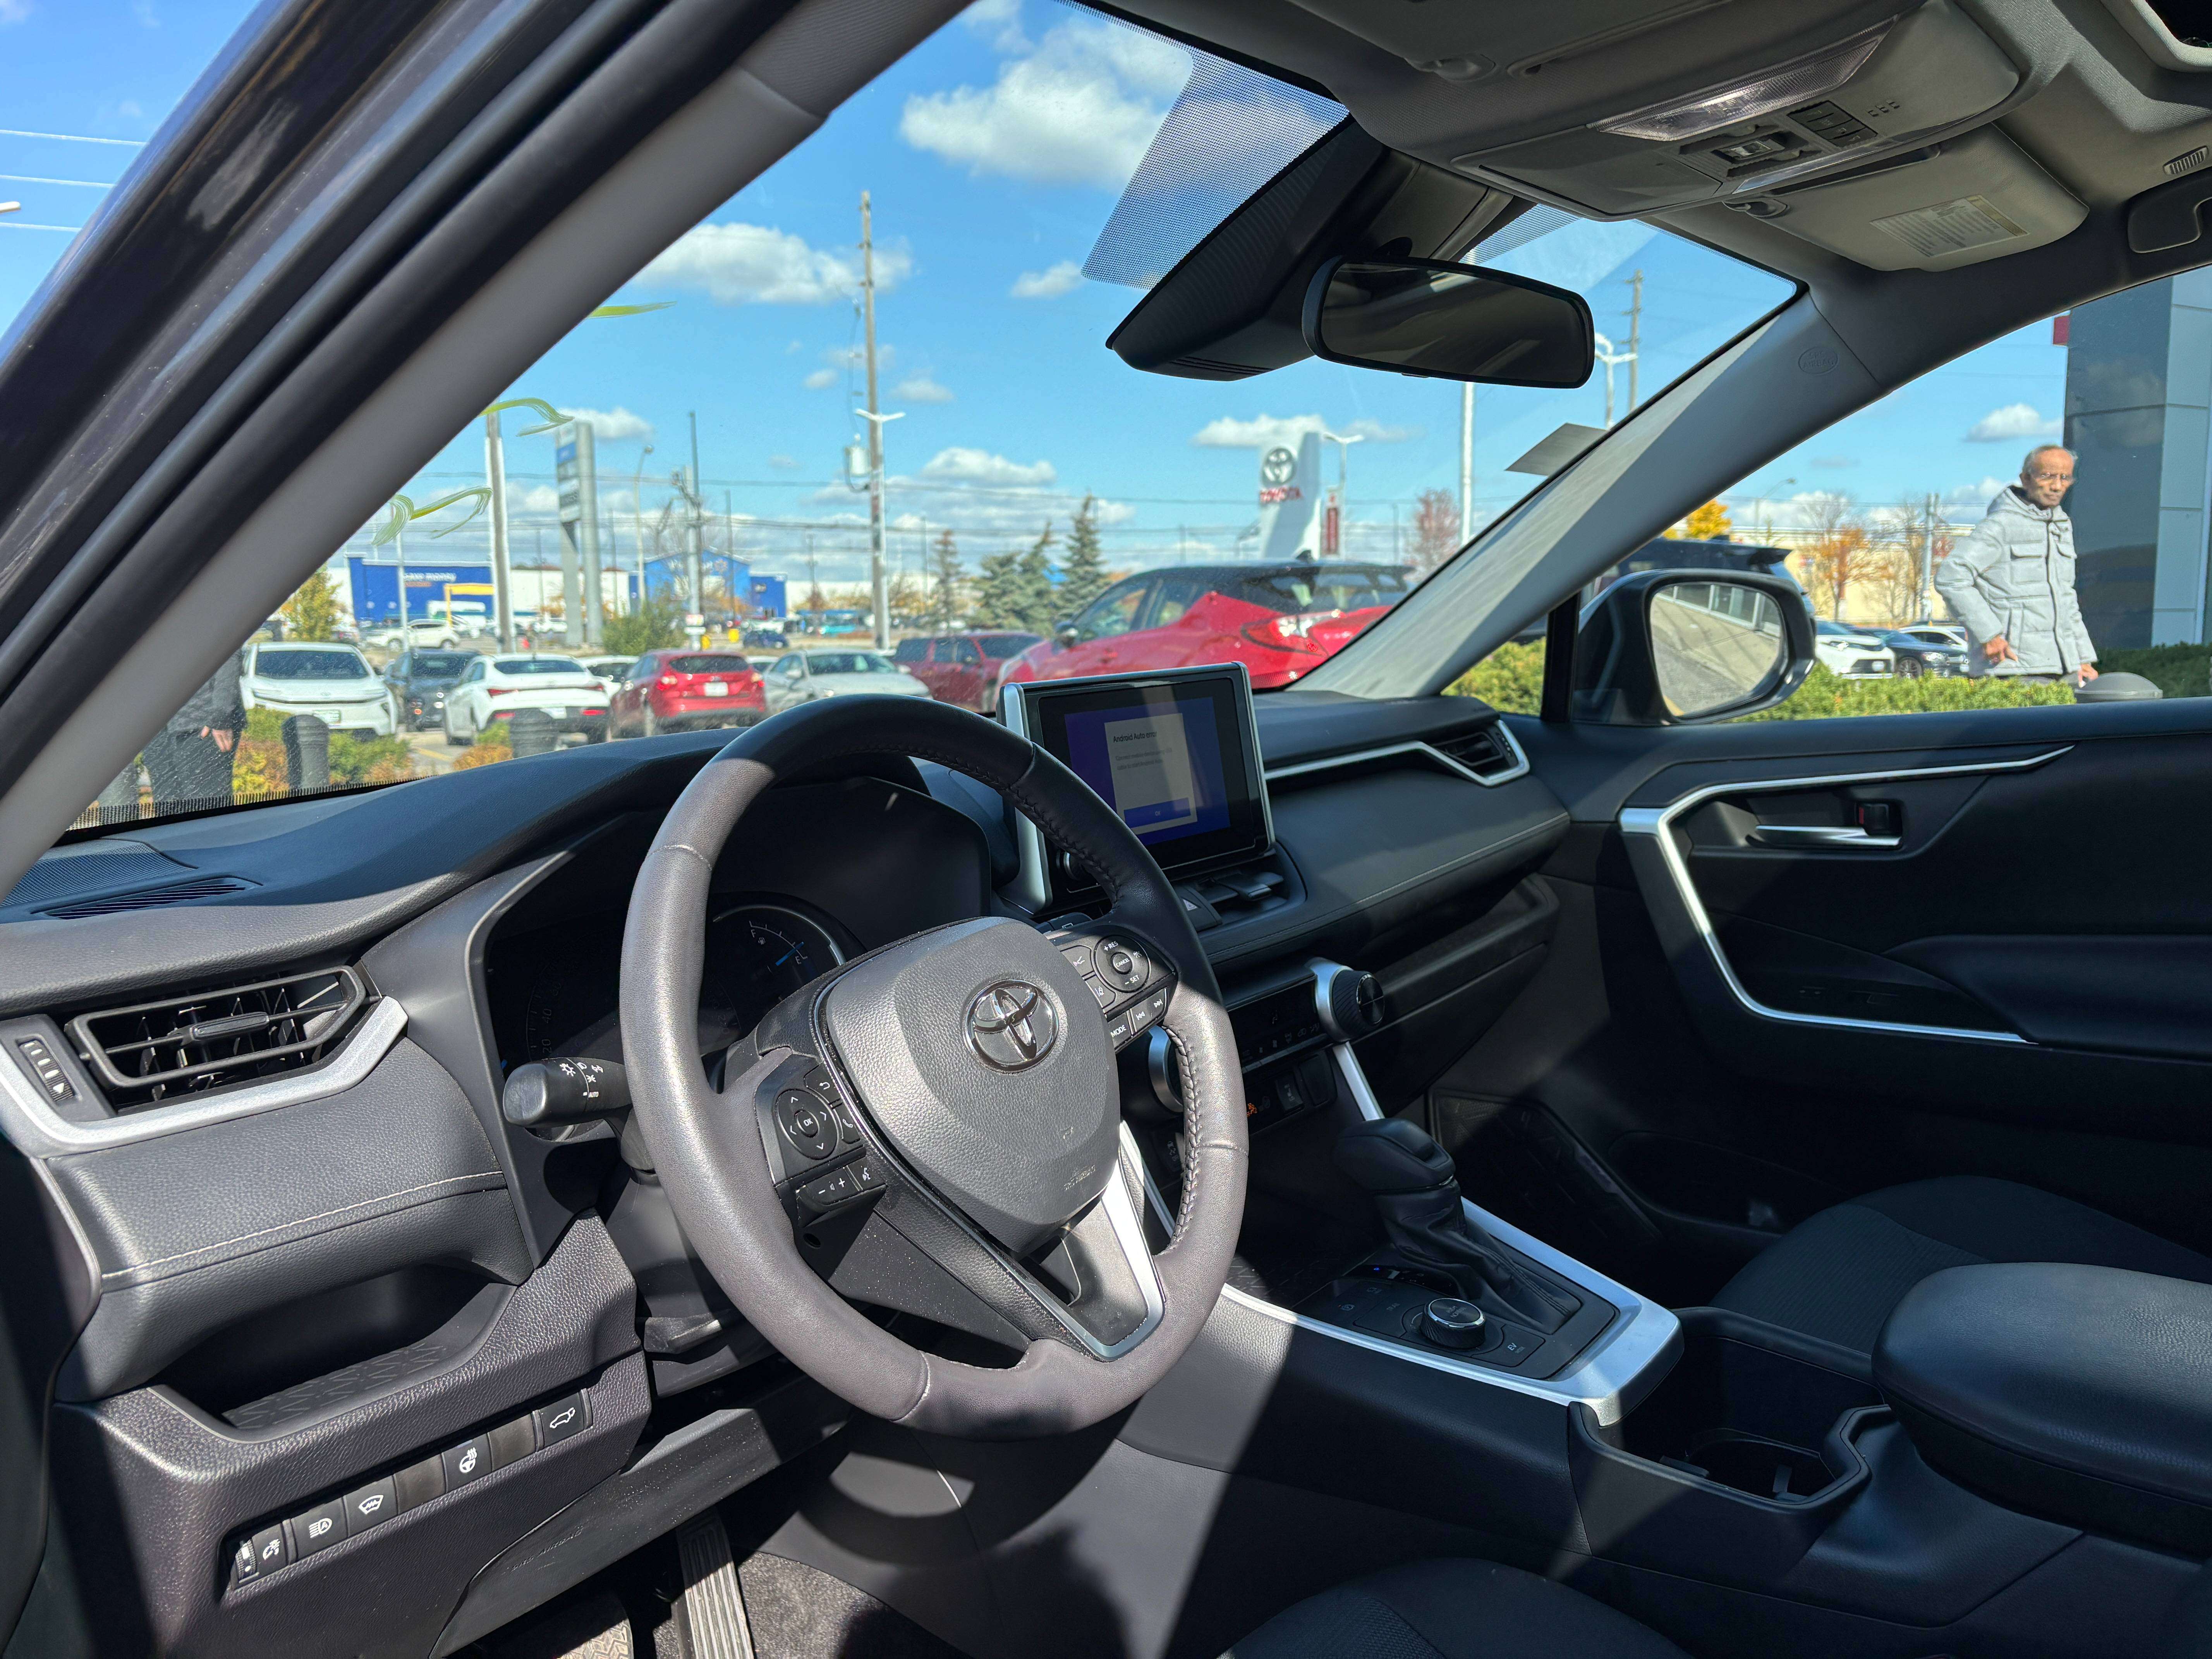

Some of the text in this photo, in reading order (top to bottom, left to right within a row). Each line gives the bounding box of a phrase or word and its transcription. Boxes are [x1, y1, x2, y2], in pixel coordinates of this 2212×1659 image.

[1113, 734, 1133, 743] Android
[1115, 958, 1130, 967] CANCEL
[1110, 1024, 1127, 1038] MODE
[803, 1118, 814, 1127] OK
[1507, 1342, 1517, 1351] EV
